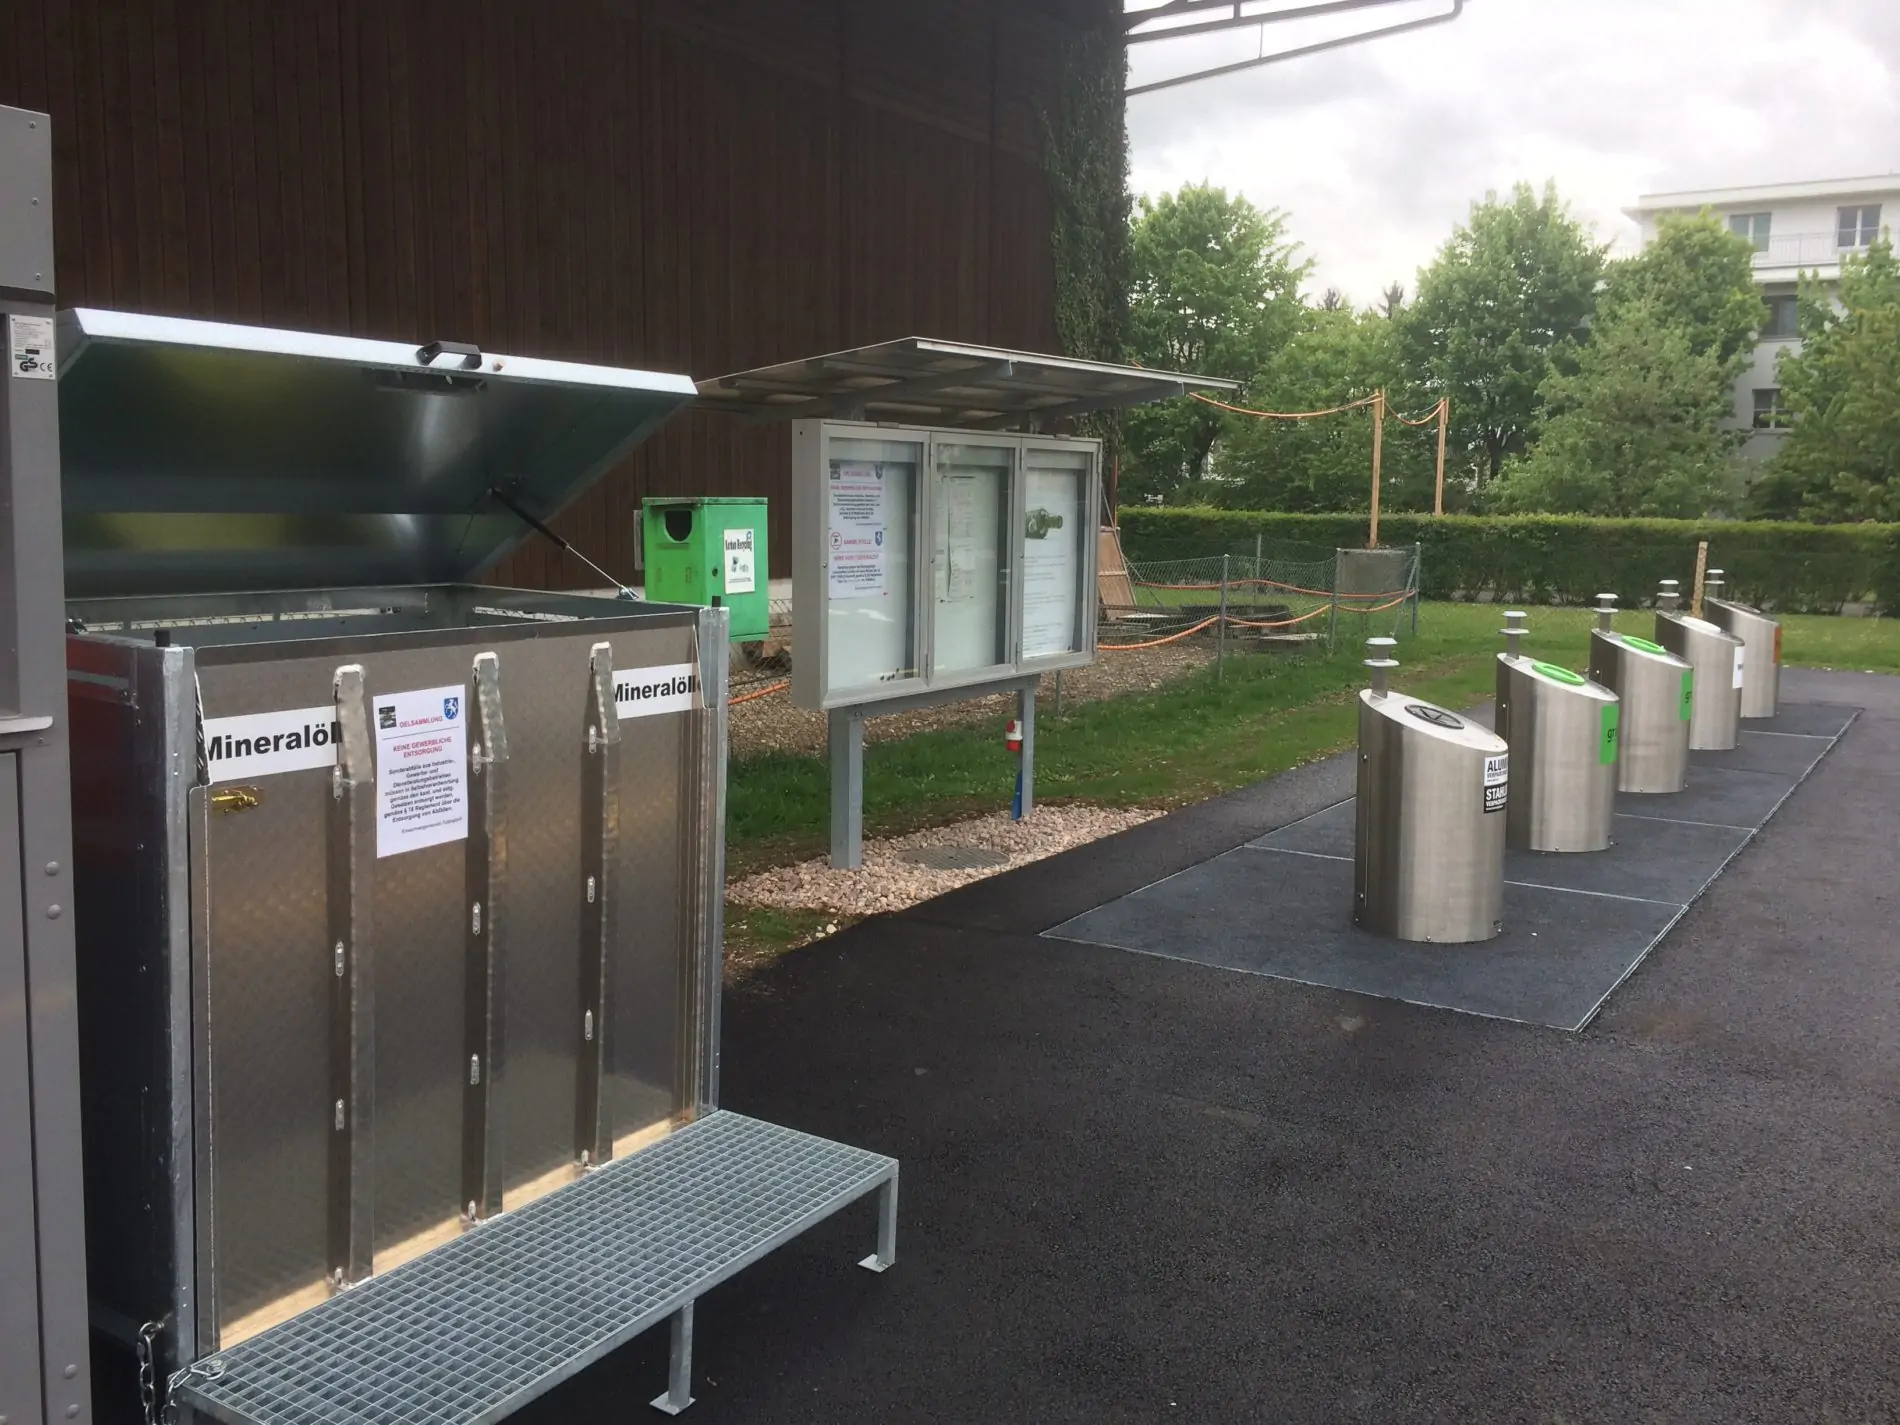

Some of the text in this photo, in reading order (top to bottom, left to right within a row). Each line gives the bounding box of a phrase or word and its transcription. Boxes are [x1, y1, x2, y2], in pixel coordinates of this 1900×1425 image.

[399, 716, 443, 728] OELSAMMLUNG
[393, 736, 452, 752] KEINE GEWERBLICHE
[403, 746, 443, 758] ENTSORGUNG
